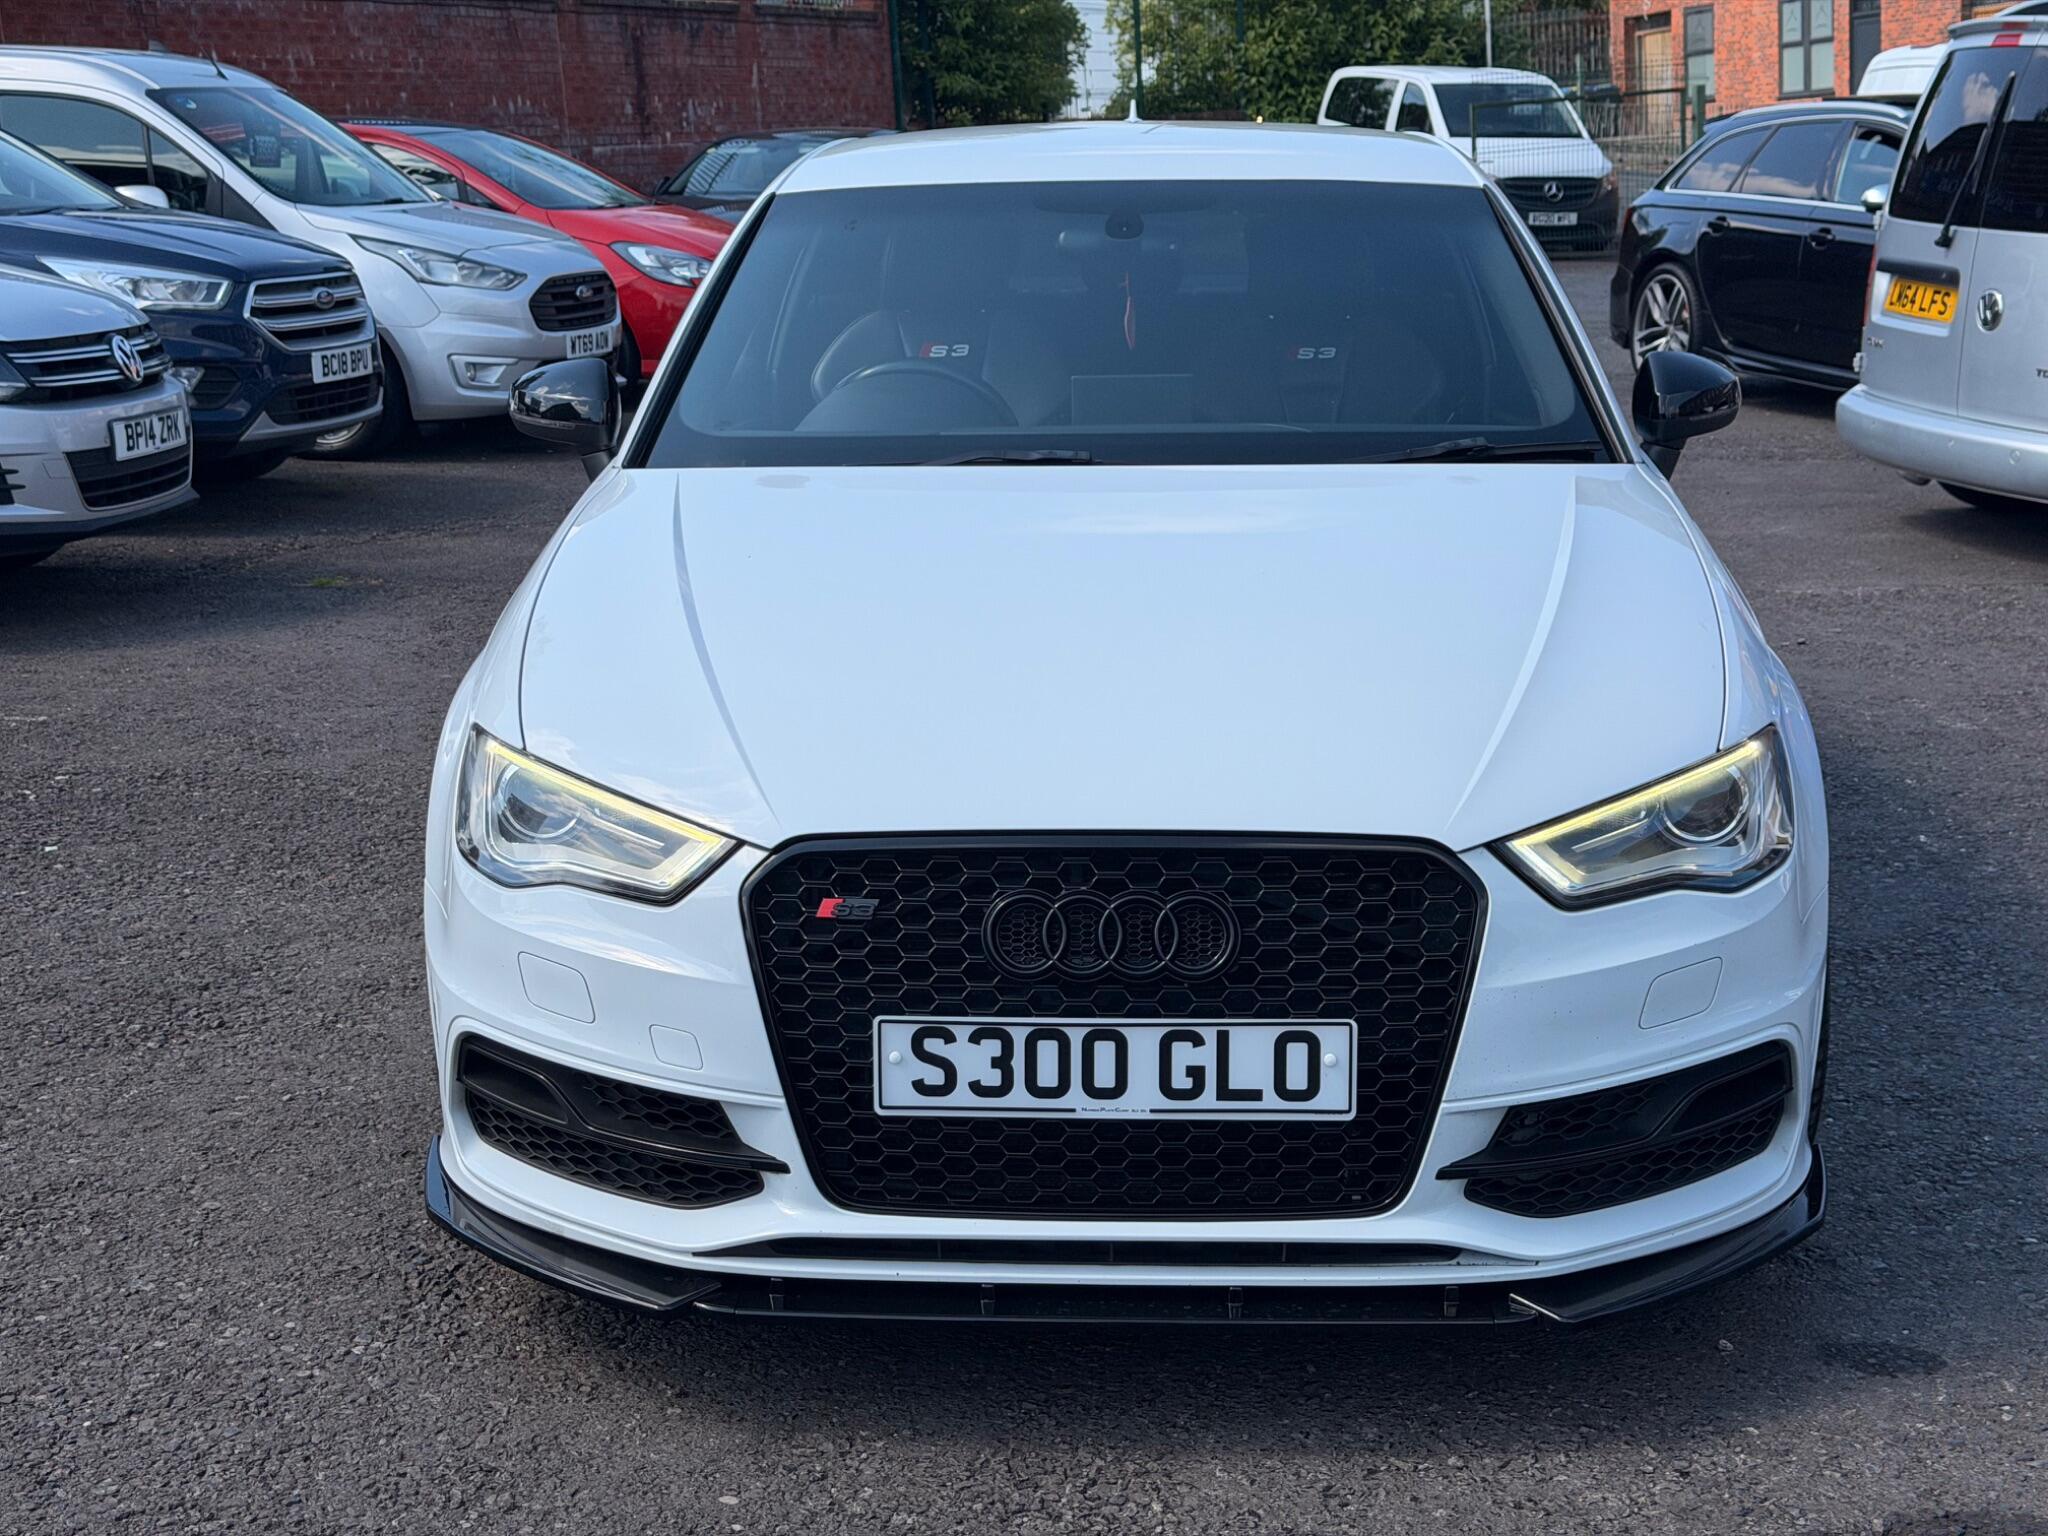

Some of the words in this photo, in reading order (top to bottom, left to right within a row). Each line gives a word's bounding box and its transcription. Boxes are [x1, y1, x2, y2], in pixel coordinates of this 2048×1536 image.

[1919, 287, 1952, 316] LFS
[570, 334, 594, 356] WT69
[929, 344, 970, 357] S3
[1297, 347, 1337, 359] S3
[321, 351, 348, 377] BC18
[350, 348, 369, 372] BPU
[125, 418, 157, 452] BP14
[158, 413, 182, 444] ZRK
[831, 897, 879, 919] S3
[910, 1025, 1129, 1100] S300
[1158, 1028, 1321, 1102] GLO
